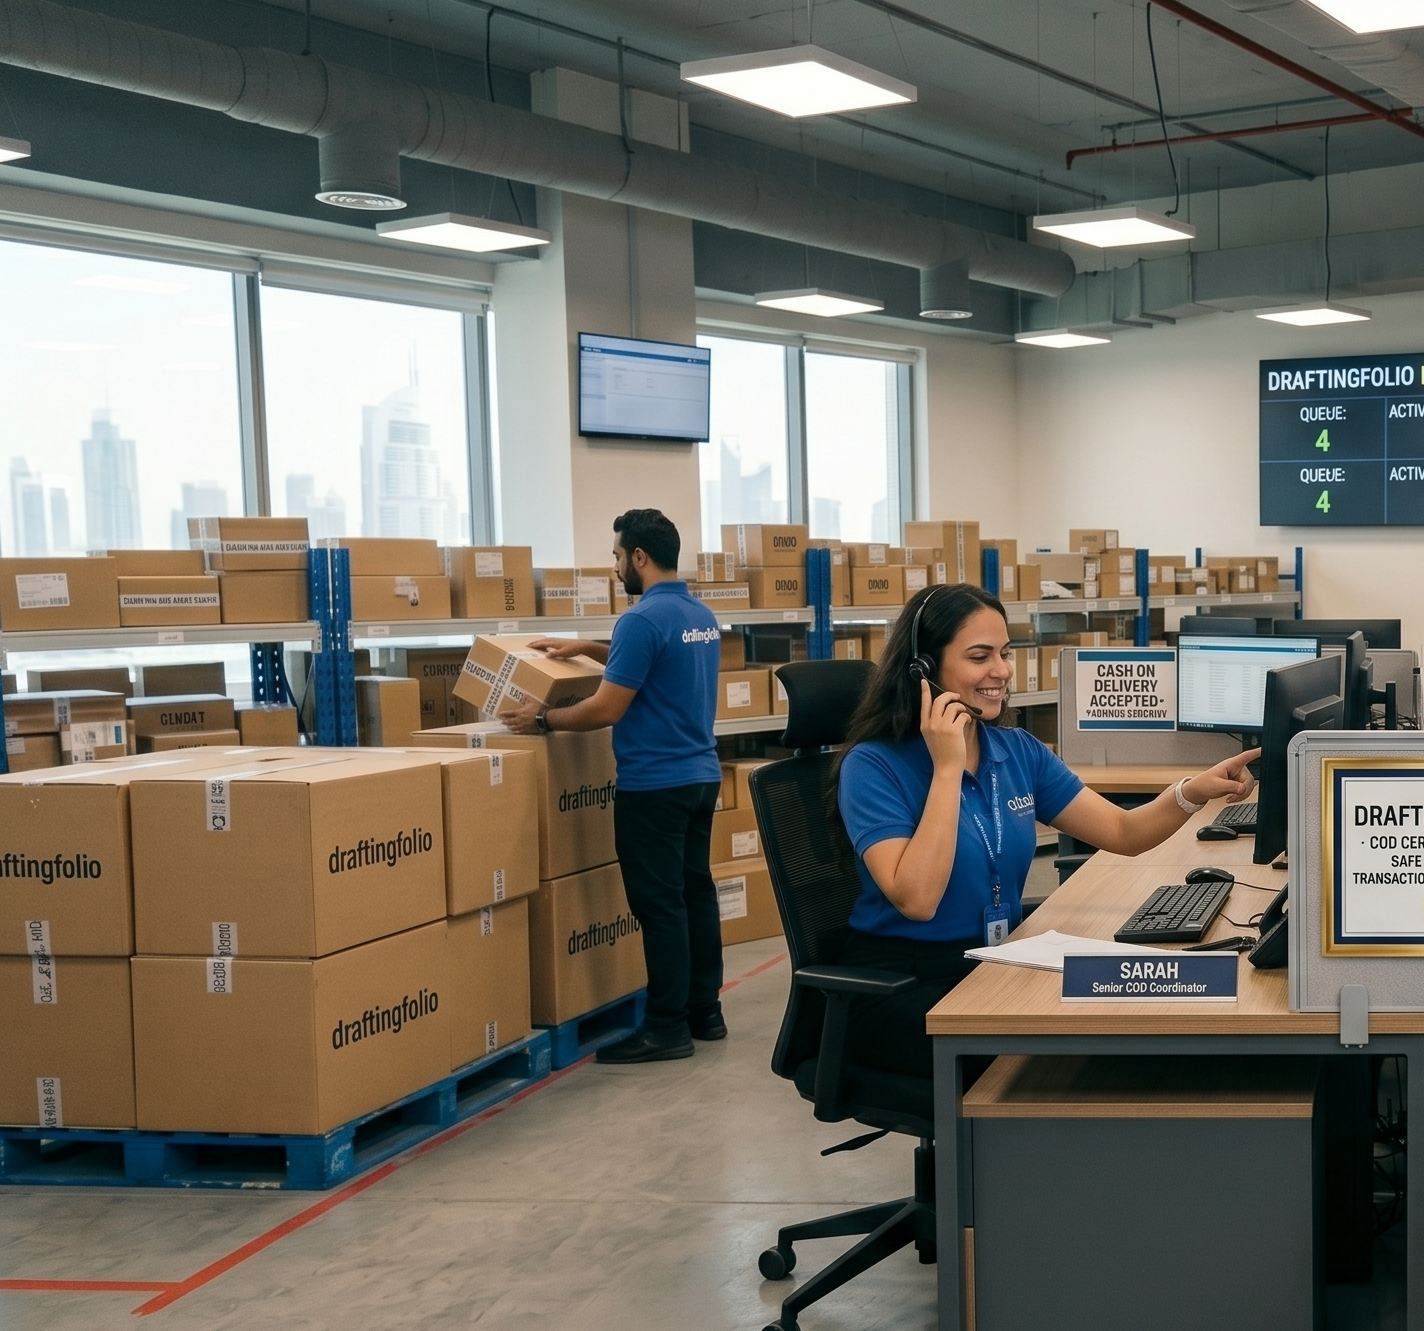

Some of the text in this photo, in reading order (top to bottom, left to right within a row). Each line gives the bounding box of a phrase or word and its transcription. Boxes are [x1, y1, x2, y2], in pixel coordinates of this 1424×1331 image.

[1268, 365, 1414, 391] DRAFTINGFOLIO
[1315, 429, 1330, 452] 4
[1315, 490, 1330, 513] 4
[1097, 664, 1156, 678] CASH ON
[1094, 679, 1158, 693] DELIVERY
[329, 828, 433, 874] draftingfolio
[1370, 836, 1397, 849] COD
[0, 853, 102, 885] ftingfolio
[1391, 855, 1422, 867] SAFE
[1120, 962, 1179, 979] SARAH
[1092, 982, 1207, 993] Senior COD Coordinator
[331, 988, 440, 1051] draftingfolio
